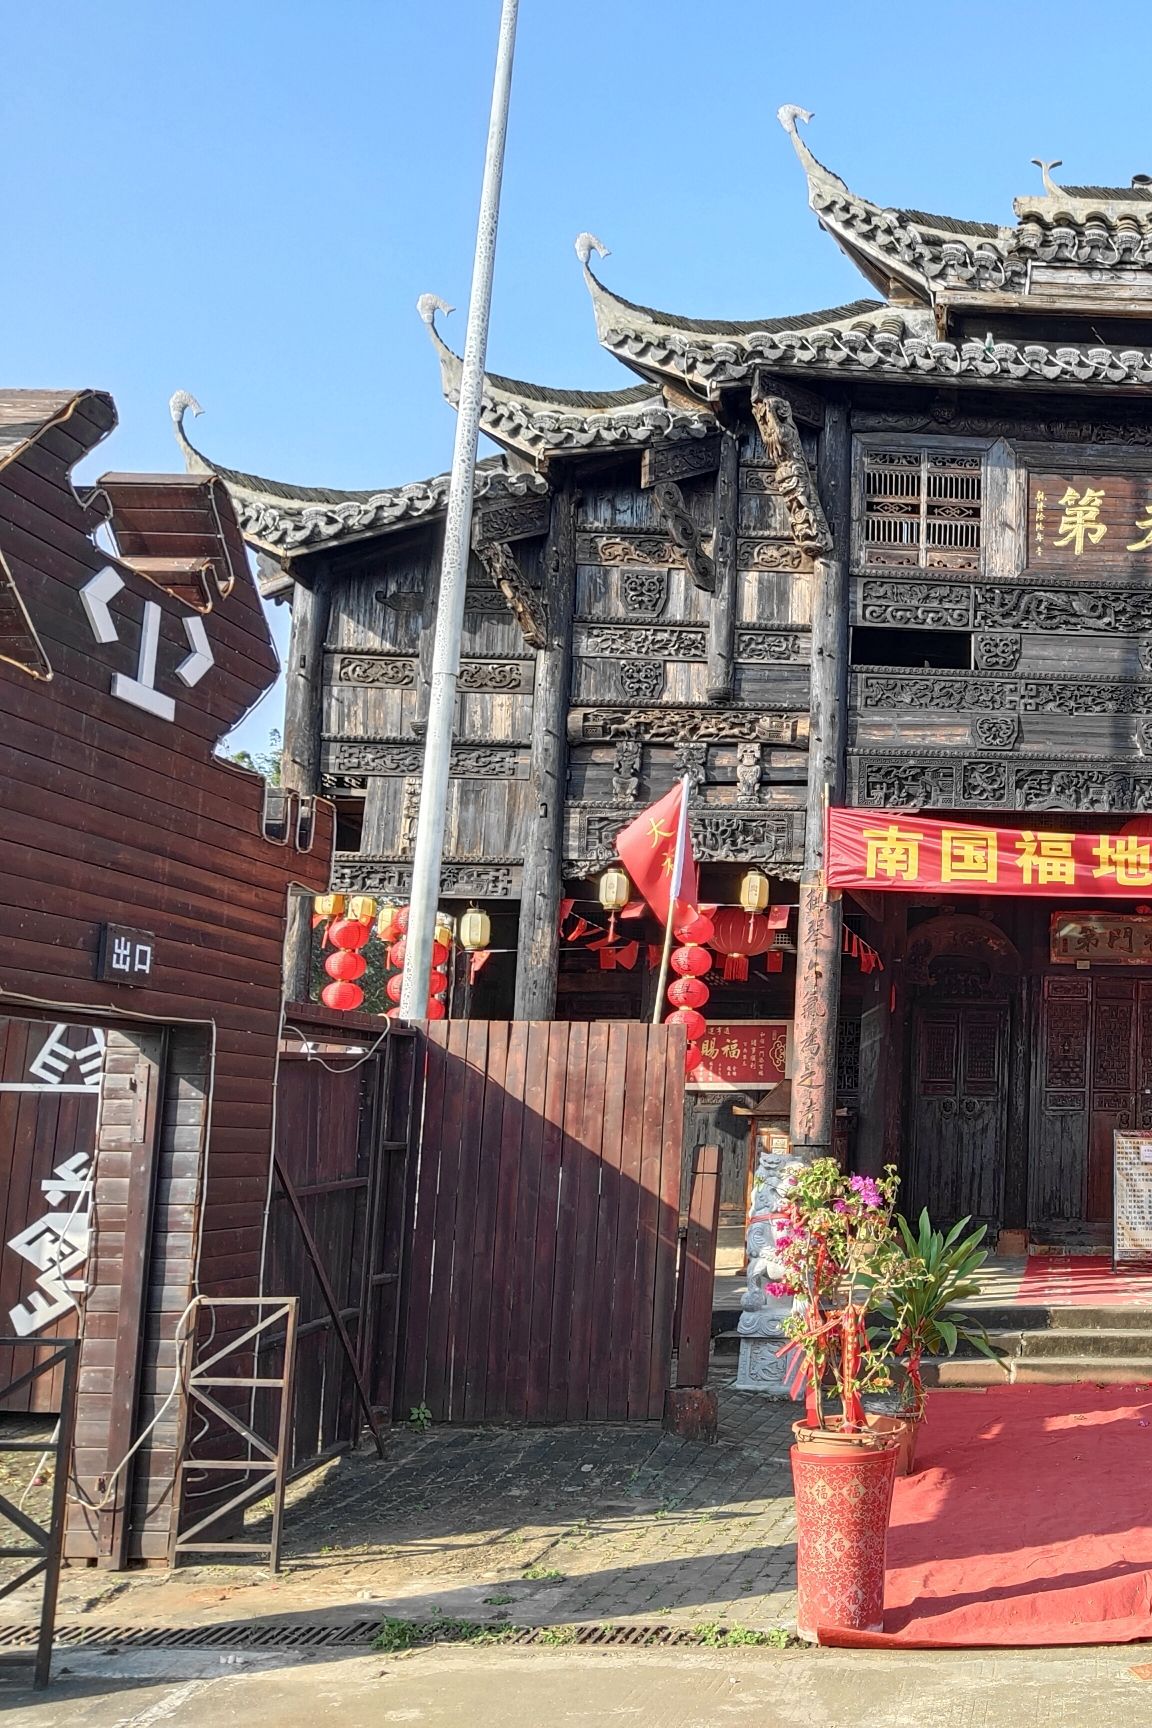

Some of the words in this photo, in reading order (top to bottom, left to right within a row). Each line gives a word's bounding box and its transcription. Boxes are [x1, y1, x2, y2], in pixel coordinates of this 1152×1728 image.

[112, 936, 151, 974] 出口
[701, 1037, 741, 1060] 賜福
[815, 1484, 829, 1500] 福
[830, 1537, 847, 1553] 福
